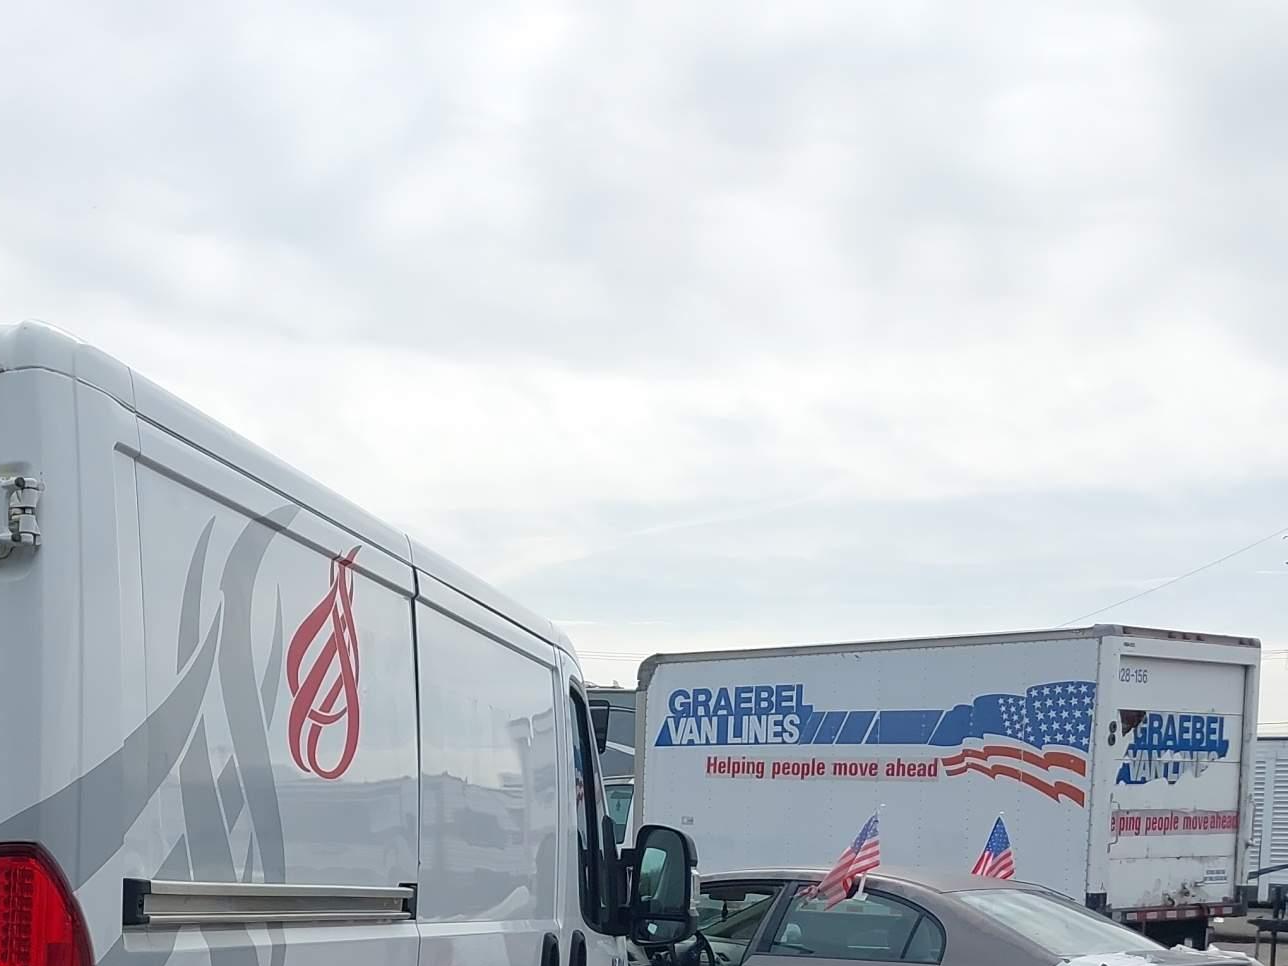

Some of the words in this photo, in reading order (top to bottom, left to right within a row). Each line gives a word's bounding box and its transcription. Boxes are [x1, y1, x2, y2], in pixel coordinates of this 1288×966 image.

[668, 684, 813, 716] GRAEBEL
[667, 715, 718, 745] VAN
[727, 713, 801, 744] LINES
[1133, 713, 1229, 750] GRAEBEL
[706, 756, 765, 779] Helping
[772, 757, 825, 780] people
[832, 761, 878, 777] move
[885, 757, 938, 777] ahead
[1110, 811, 1141, 836] eping
[1144, 811, 1179, 835] people
[1182, 815, 1208, 830] move
